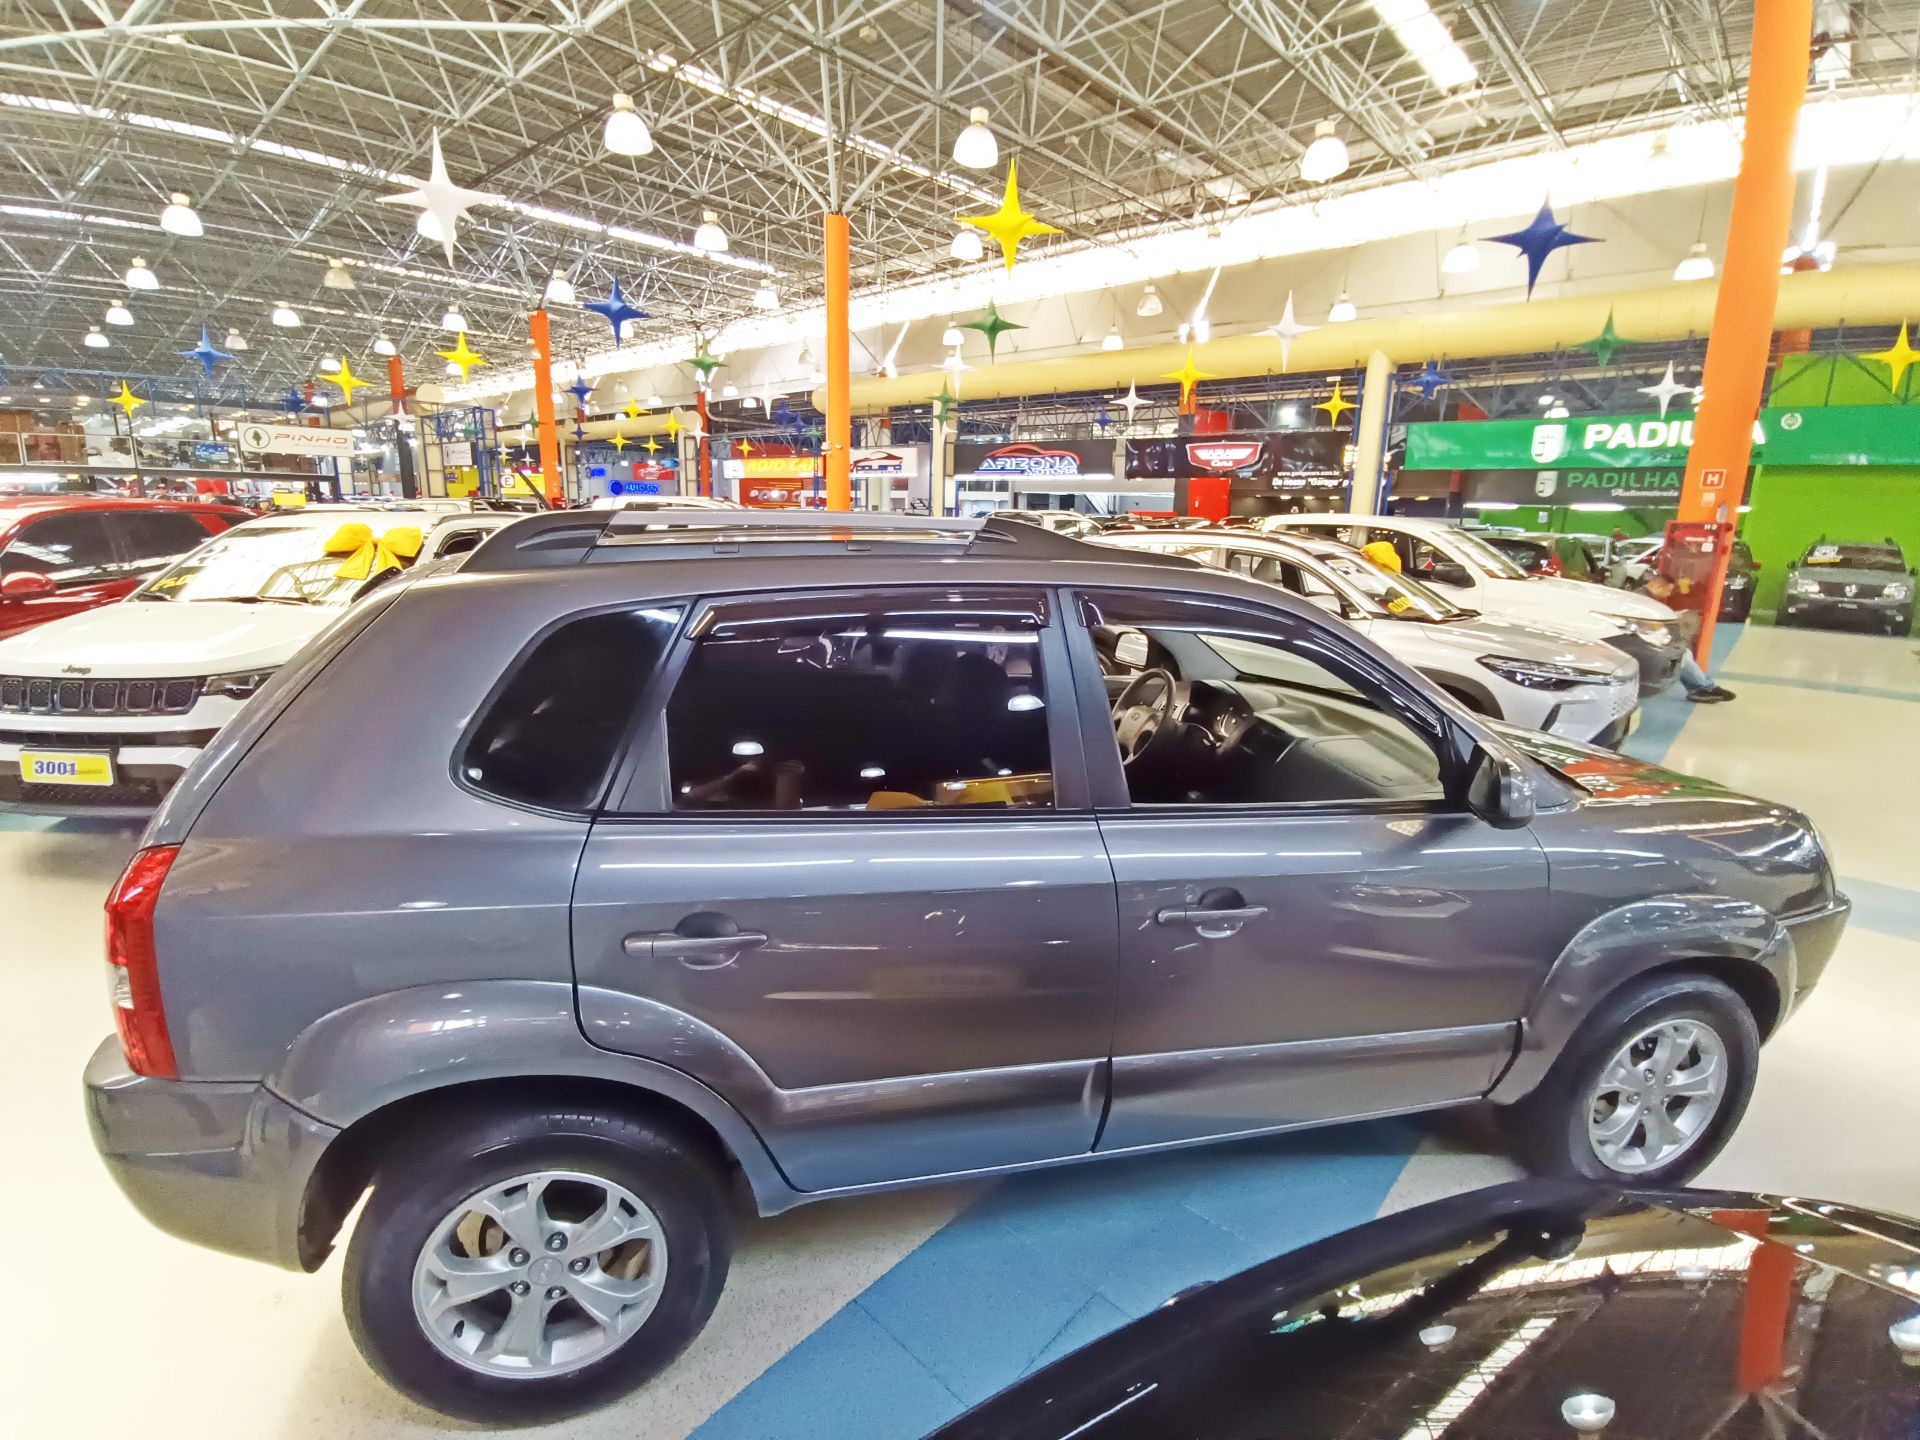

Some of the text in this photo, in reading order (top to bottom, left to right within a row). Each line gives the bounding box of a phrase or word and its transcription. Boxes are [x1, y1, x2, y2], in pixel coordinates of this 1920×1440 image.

[1582, 420, 1766, 449] PADILA
[978, 455, 1078, 470] ARIZONA
[1566, 471, 1681, 489] PADILHA
[1706, 473, 1720, 485] H
[61, 664, 92, 675] Jeep
[34, 759, 77, 776] 3001
